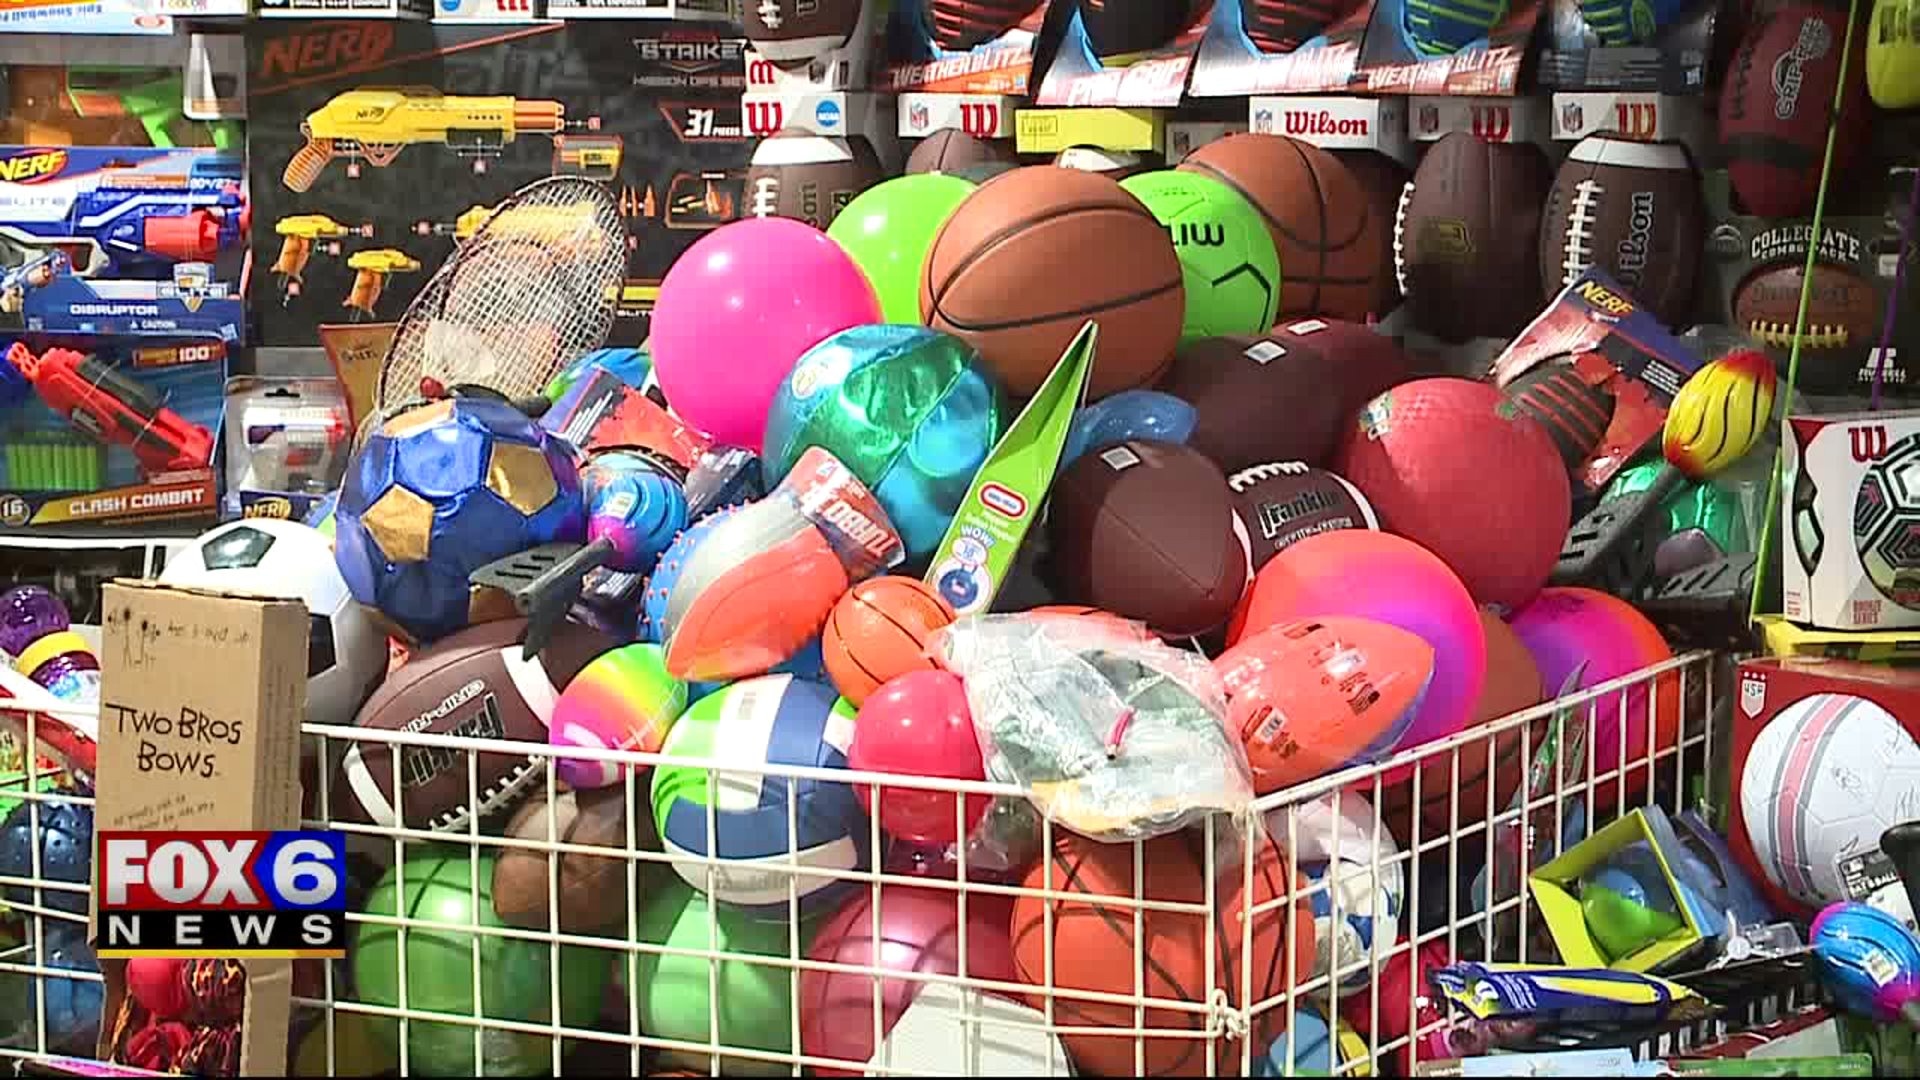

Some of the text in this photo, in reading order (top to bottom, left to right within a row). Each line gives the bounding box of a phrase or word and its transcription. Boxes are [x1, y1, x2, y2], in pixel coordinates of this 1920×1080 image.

[684, 108, 714, 137] 31
[1284, 110, 1368, 136] Wilson
[0, 151, 66, 182] NERF
[1574, 280, 1634, 316] NERF
[68, 487, 206, 515] CLASH COMBAT
[105, 702, 243, 745] TWO BROS
